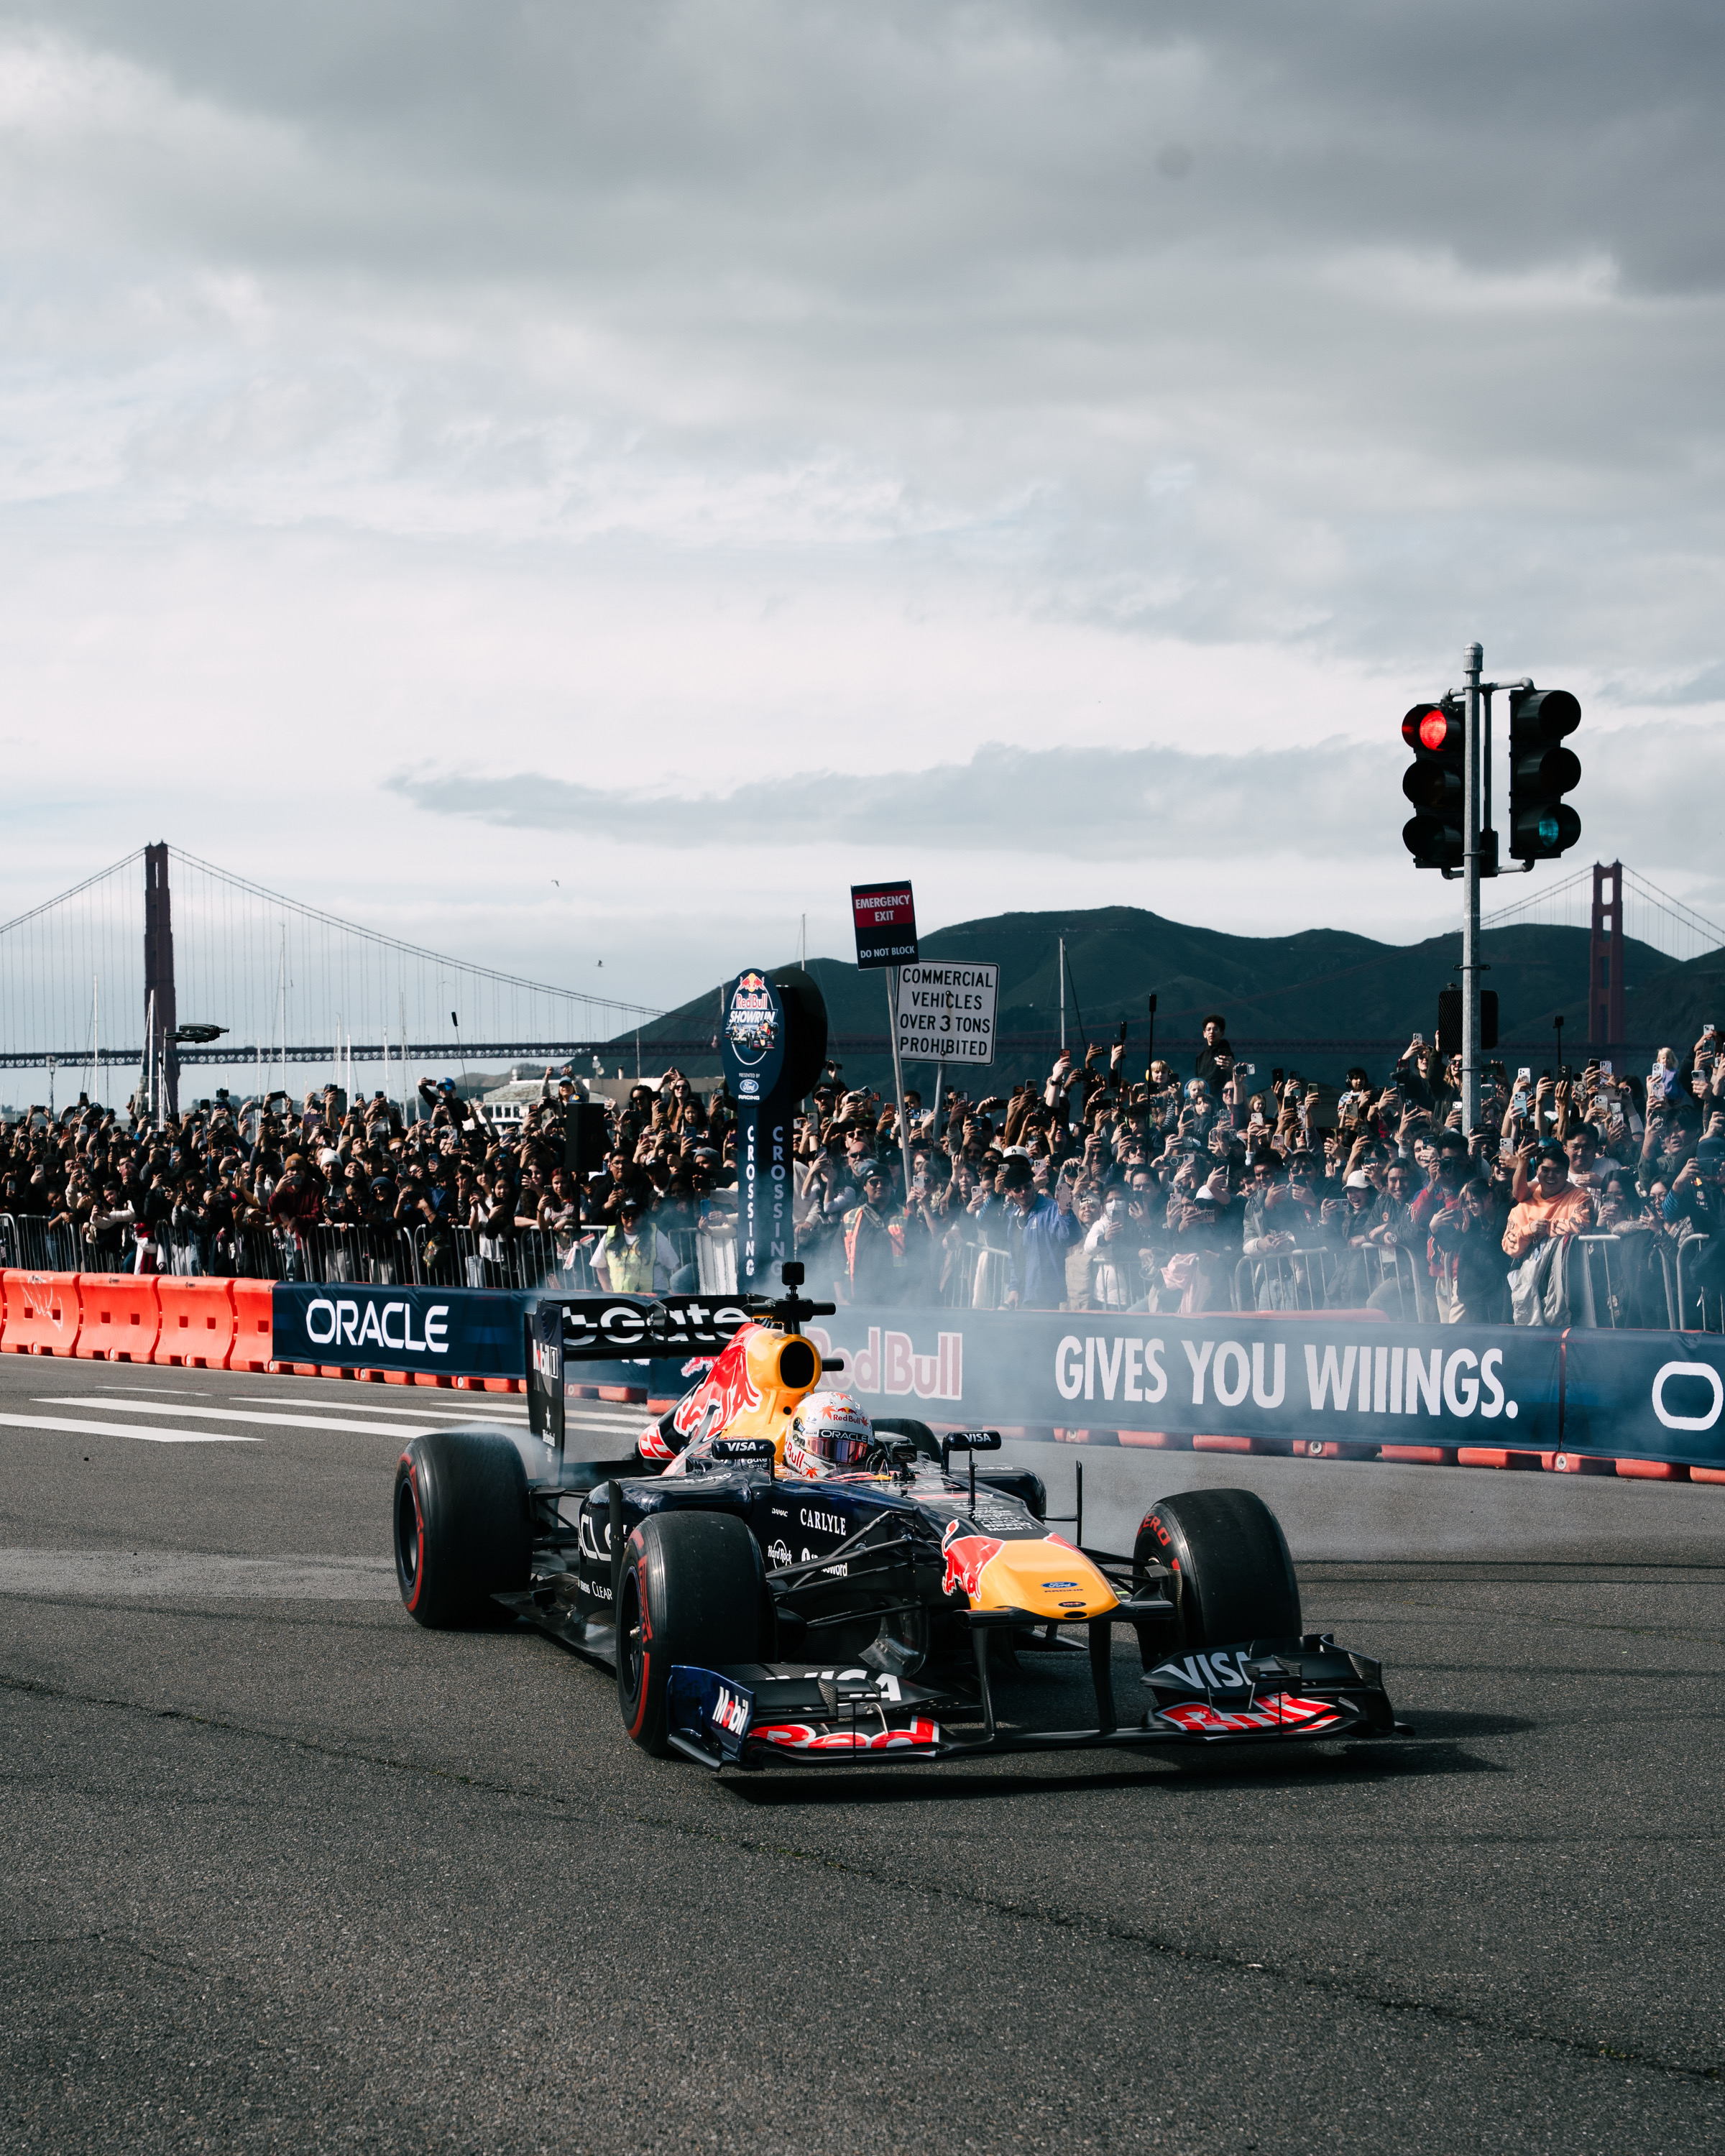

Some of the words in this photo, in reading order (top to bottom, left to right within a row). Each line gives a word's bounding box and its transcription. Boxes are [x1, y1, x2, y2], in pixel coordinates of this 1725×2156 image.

[855, 895, 911, 910] EMERGENCY
[875, 911, 894, 922] EXIT
[860, 949, 872, 959] DO
[874, 948, 889, 957] NOT
[891, 946, 915, 956] BLOCK
[902, 968, 993, 987] COMMERCIAL
[736, 993, 752, 1008] Red
[752, 993, 768, 1009] Bull
[911, 991, 982, 1010] VEHICLES
[729, 1010, 776, 1023] SHOWRUN
[900, 1013, 936, 1031] OVER
[939, 1015, 951, 1032] 3
[955, 1017, 990, 1033] TONS
[900, 1036, 988, 1056] PROHIBITED
[742, 1082, 755, 1091] Ford
[745, 1125, 755, 1276] CROSSING
[305, 1299, 449, 1353] ORACLE
[884, 1330, 963, 1401] Bull
[1055, 1335, 1168, 1404] GIVES
[1181, 1340, 1286, 1409] YOU
[1305, 1345, 1519, 1419] WIIINGS.
[848, 1415, 860, 1424] Bull
[821, 1429, 868, 1443] ORACLE
[962, 1433, 991, 1442] VISA
[724, 1442, 756, 1451] VISA
[772, 1508, 788, 1517] DAMAC
[800, 1508, 846, 1536] CARLYLE
[768, 1545, 780, 1560] Hard
[781, 1547, 792, 1565] Rock
[712, 1686, 749, 1736] Mobil
